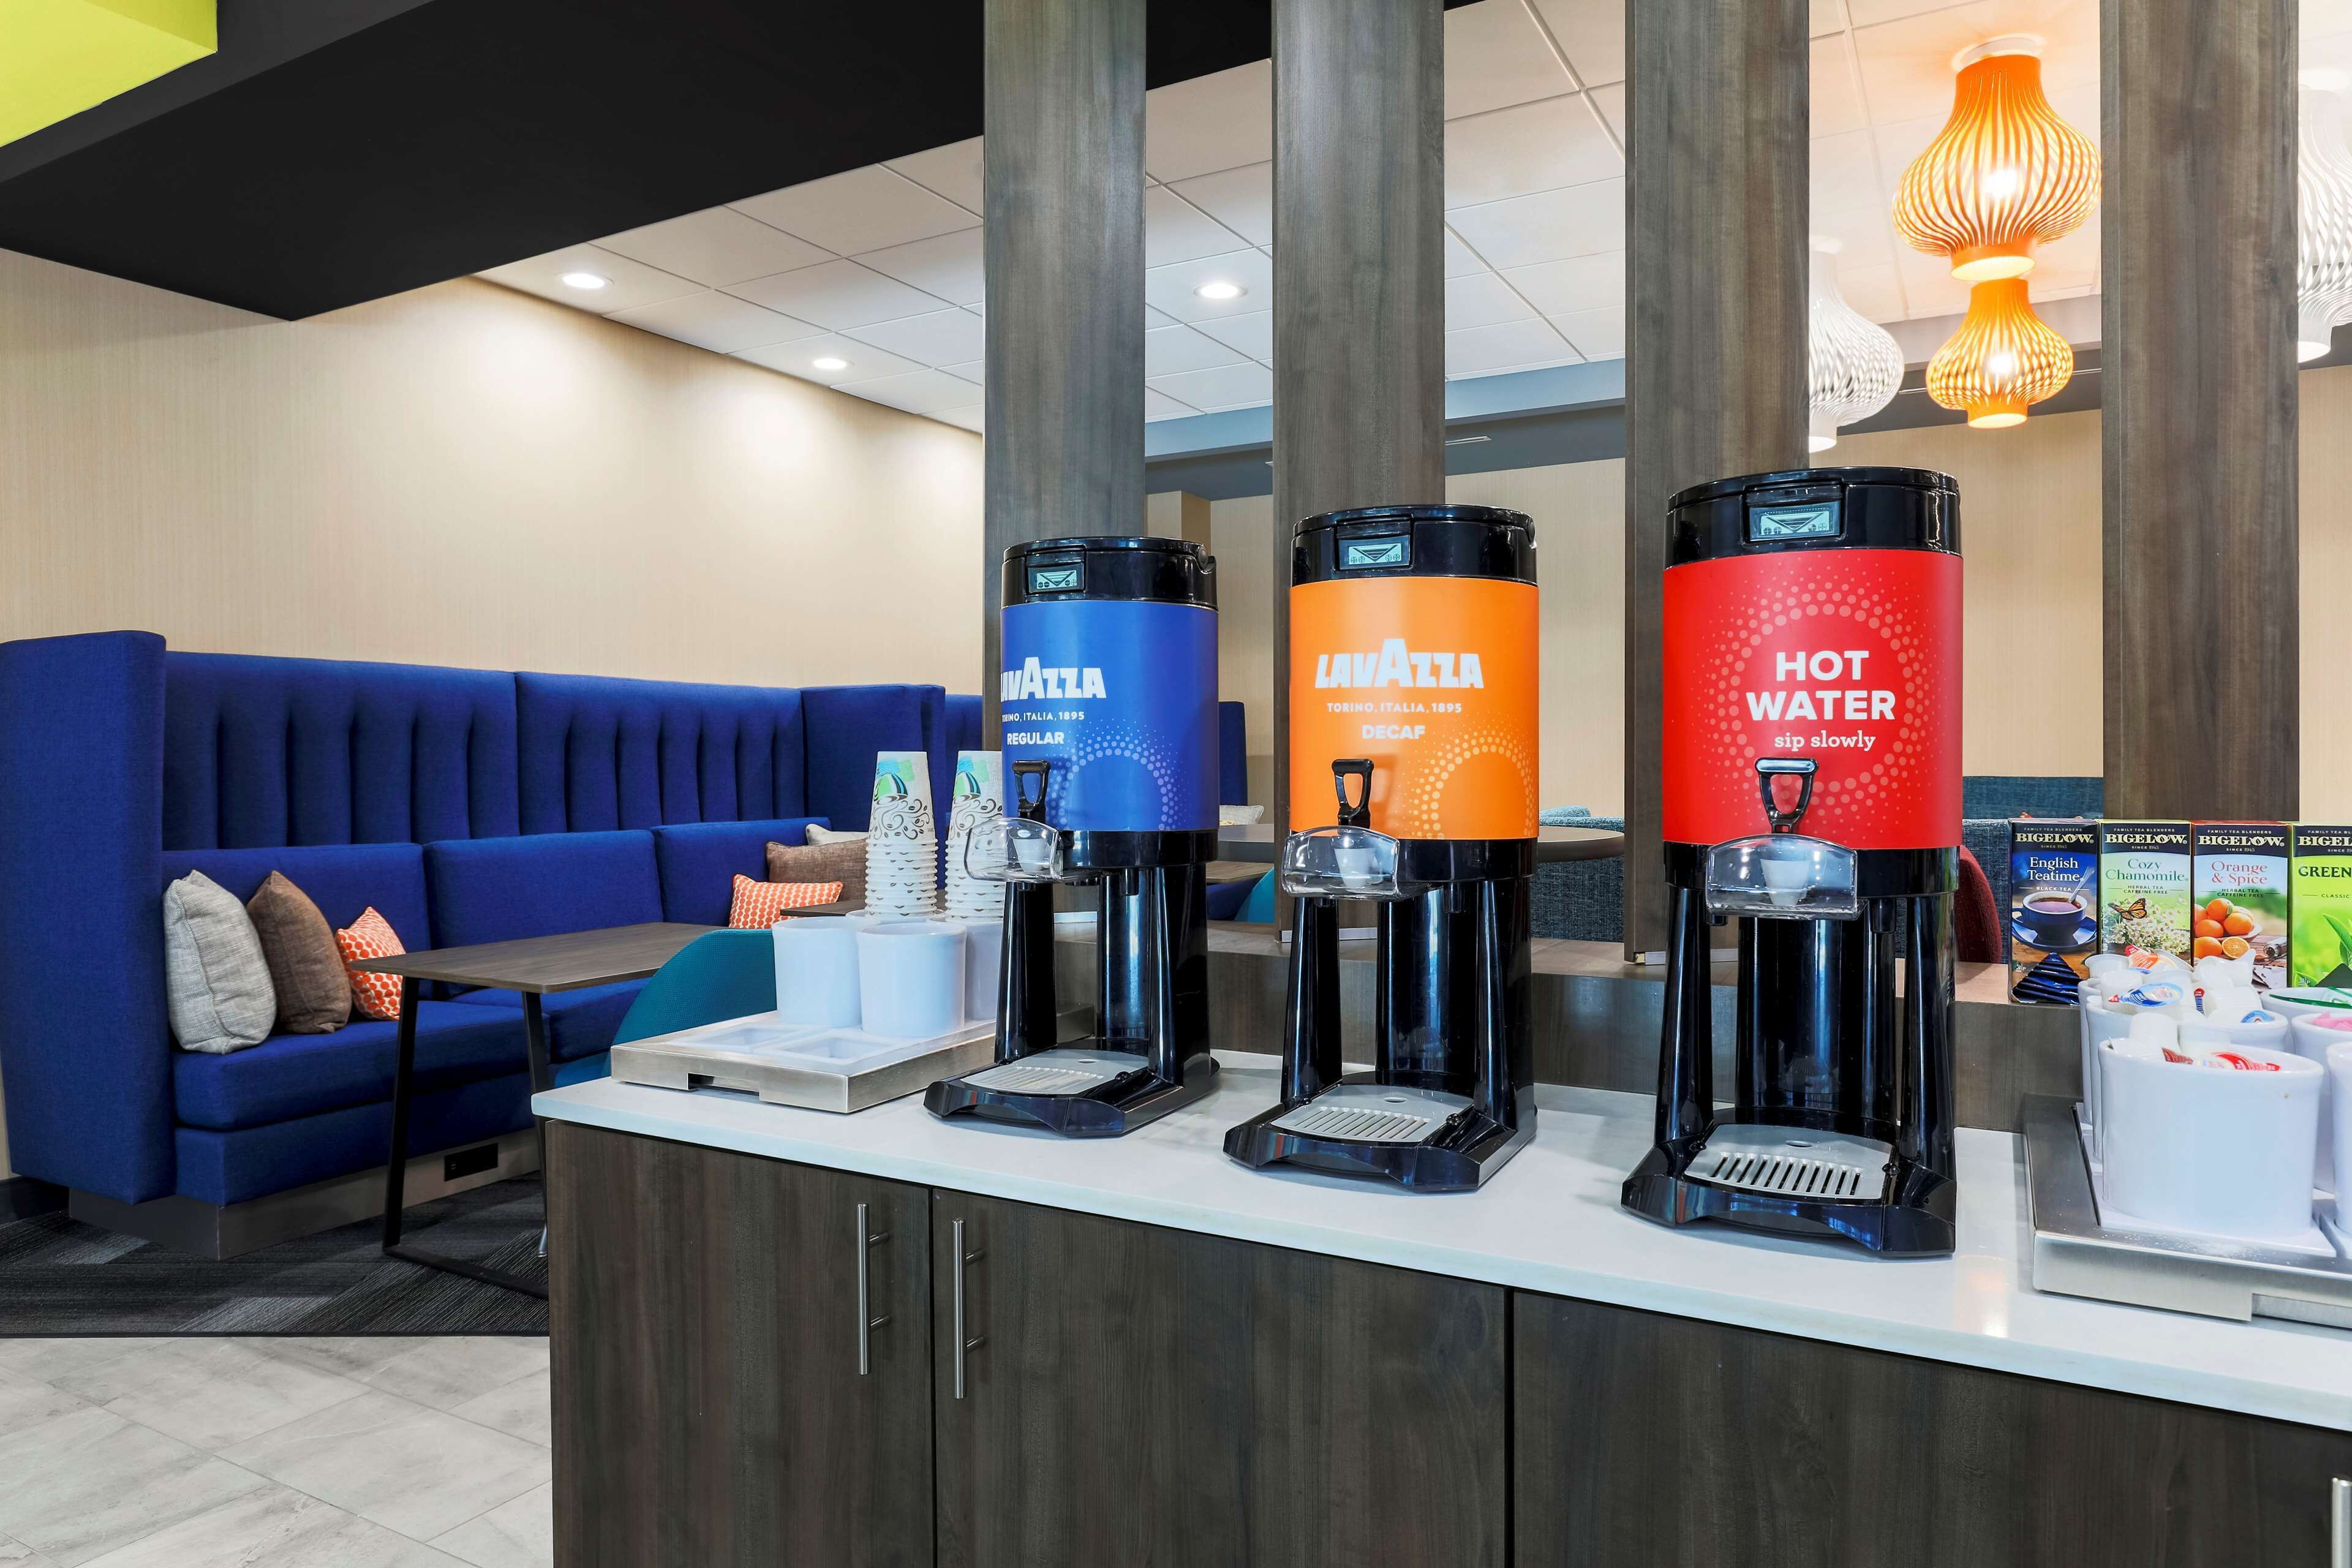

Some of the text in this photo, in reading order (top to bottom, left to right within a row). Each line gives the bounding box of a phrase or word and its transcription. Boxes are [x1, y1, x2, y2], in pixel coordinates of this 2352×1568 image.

[1314, 638, 1485, 688] LAVAZZA
[1776, 650, 1869, 681] HOT
[1381, 703, 1430, 713] ITALIA,
[1431, 703, 1462, 713] 1895
[1746, 690, 1896, 721] WATER
[1023, 712, 1057, 722] ITALIA,
[1058, 711, 1085, 720] 1895
[1007, 731, 1065, 745] REGULAR
[1362, 725, 1426, 739] DECAF
[1774, 729, 1876, 752] sip slowly
[2029, 857, 2078, 871] English
[2127, 858, 2162, 872] Cozy
[2211, 861, 2267, 875] Orange
[2105, 869, 2185, 881] Chamomile
[2298, 866, 2351, 878] GREEN
[2212, 873, 2267, 886] & Spice
